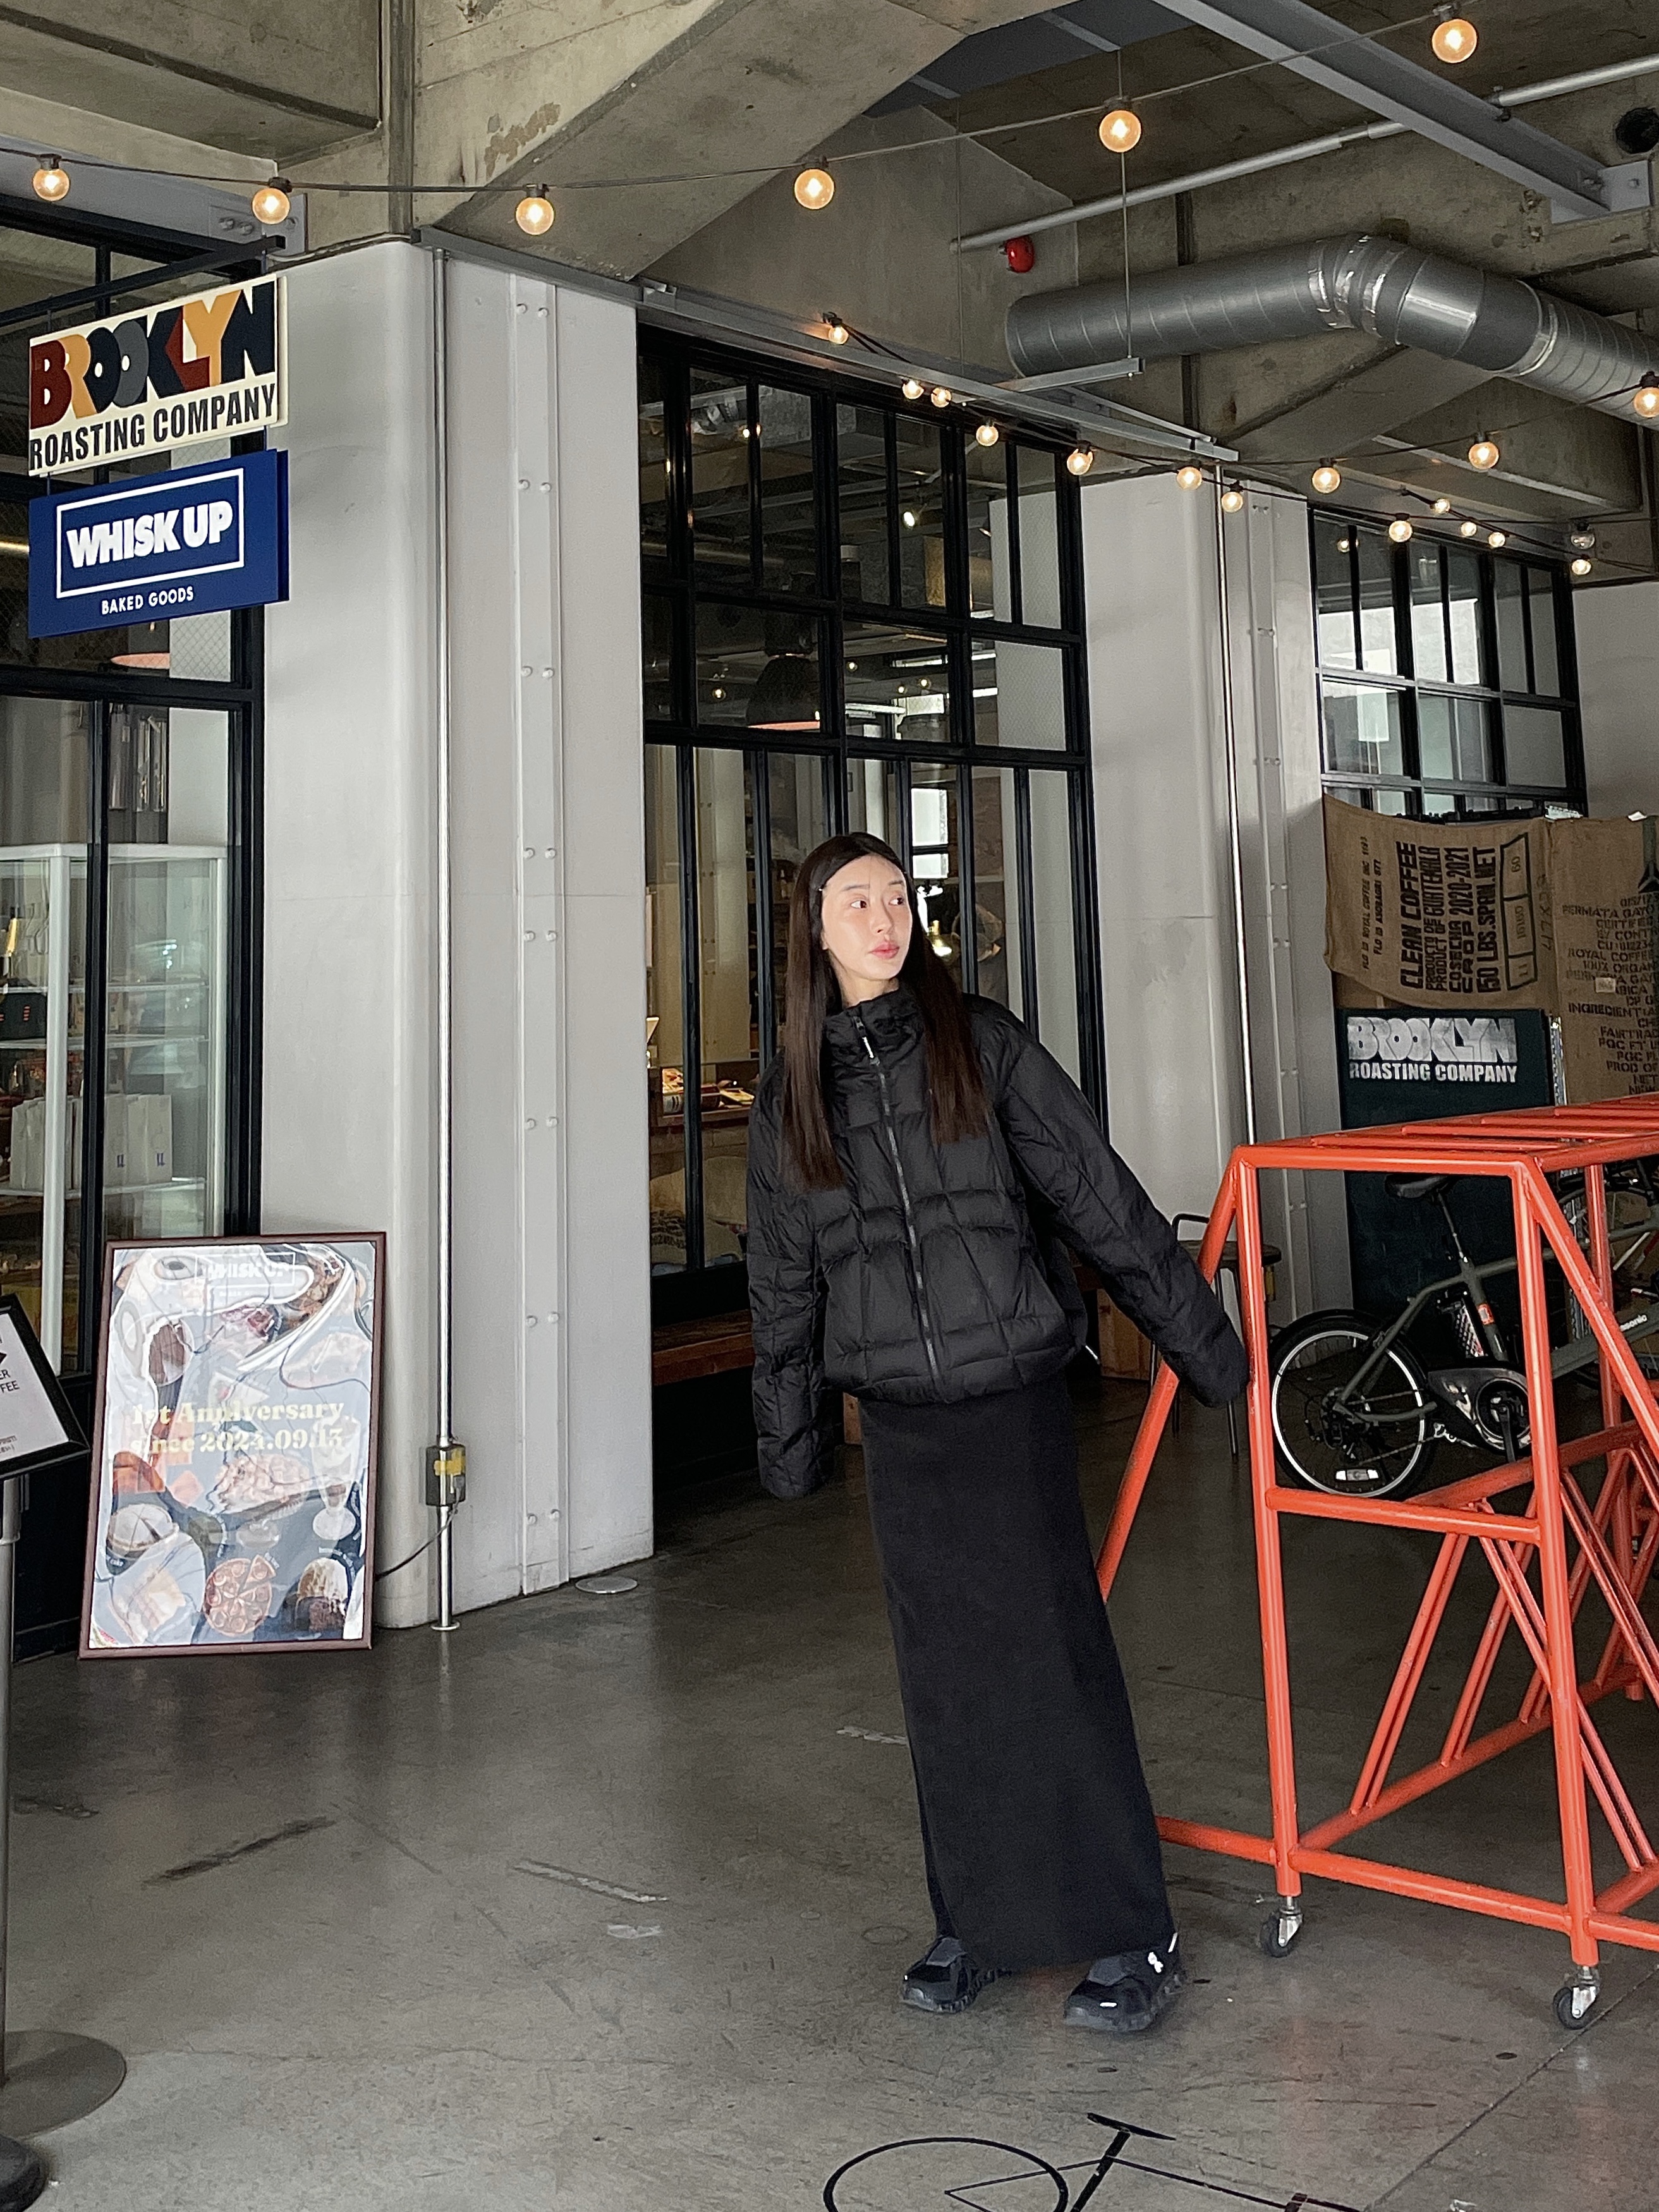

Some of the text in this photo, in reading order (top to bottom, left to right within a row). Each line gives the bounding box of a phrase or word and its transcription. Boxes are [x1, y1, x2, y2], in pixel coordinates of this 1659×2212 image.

[30, 281, 275, 429] BROOKLYN
[29, 384, 275, 471] ROASTING COMPANY
[66, 501, 233, 568] WHISK UP
[102, 586, 193, 616] BAKED GOODS
[1395, 841, 1423, 988] CLEAN COFFEE
[1418, 846, 1445, 990] PRODUCTO DE GUATEMALA
[1444, 848, 1473, 992] COSECHA 2020-2021
[1435, 919, 1447, 992] PRODUCT OF
[1462, 921, 1474, 994] CROP
[1347, 1016, 1517, 1063] BROOKLYN
[1349, 1062, 1517, 1083] ROASTING COMPANY
